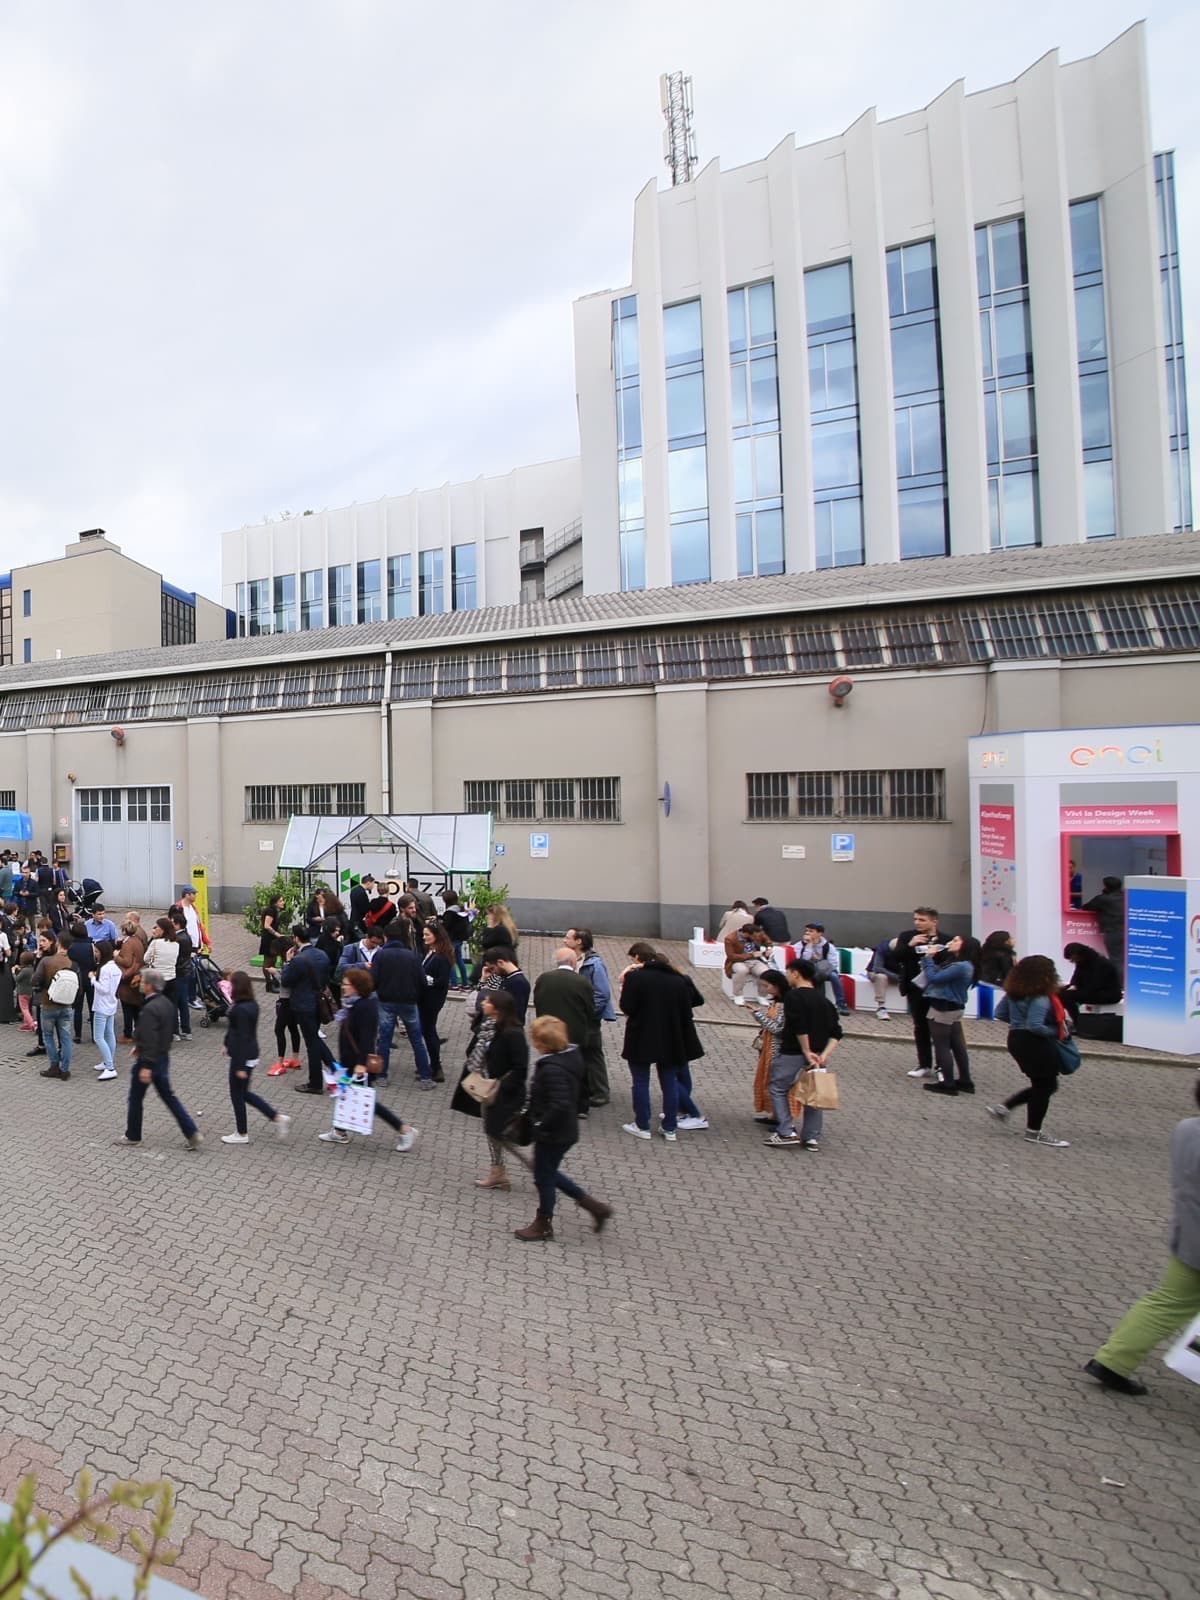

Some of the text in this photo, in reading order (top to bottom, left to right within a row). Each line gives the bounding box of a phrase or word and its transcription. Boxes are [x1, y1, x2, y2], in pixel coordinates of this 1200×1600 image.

[1070, 739, 1163, 767] enel
[1095, 810, 1126, 818] Design
[835, 836, 850, 850] P
